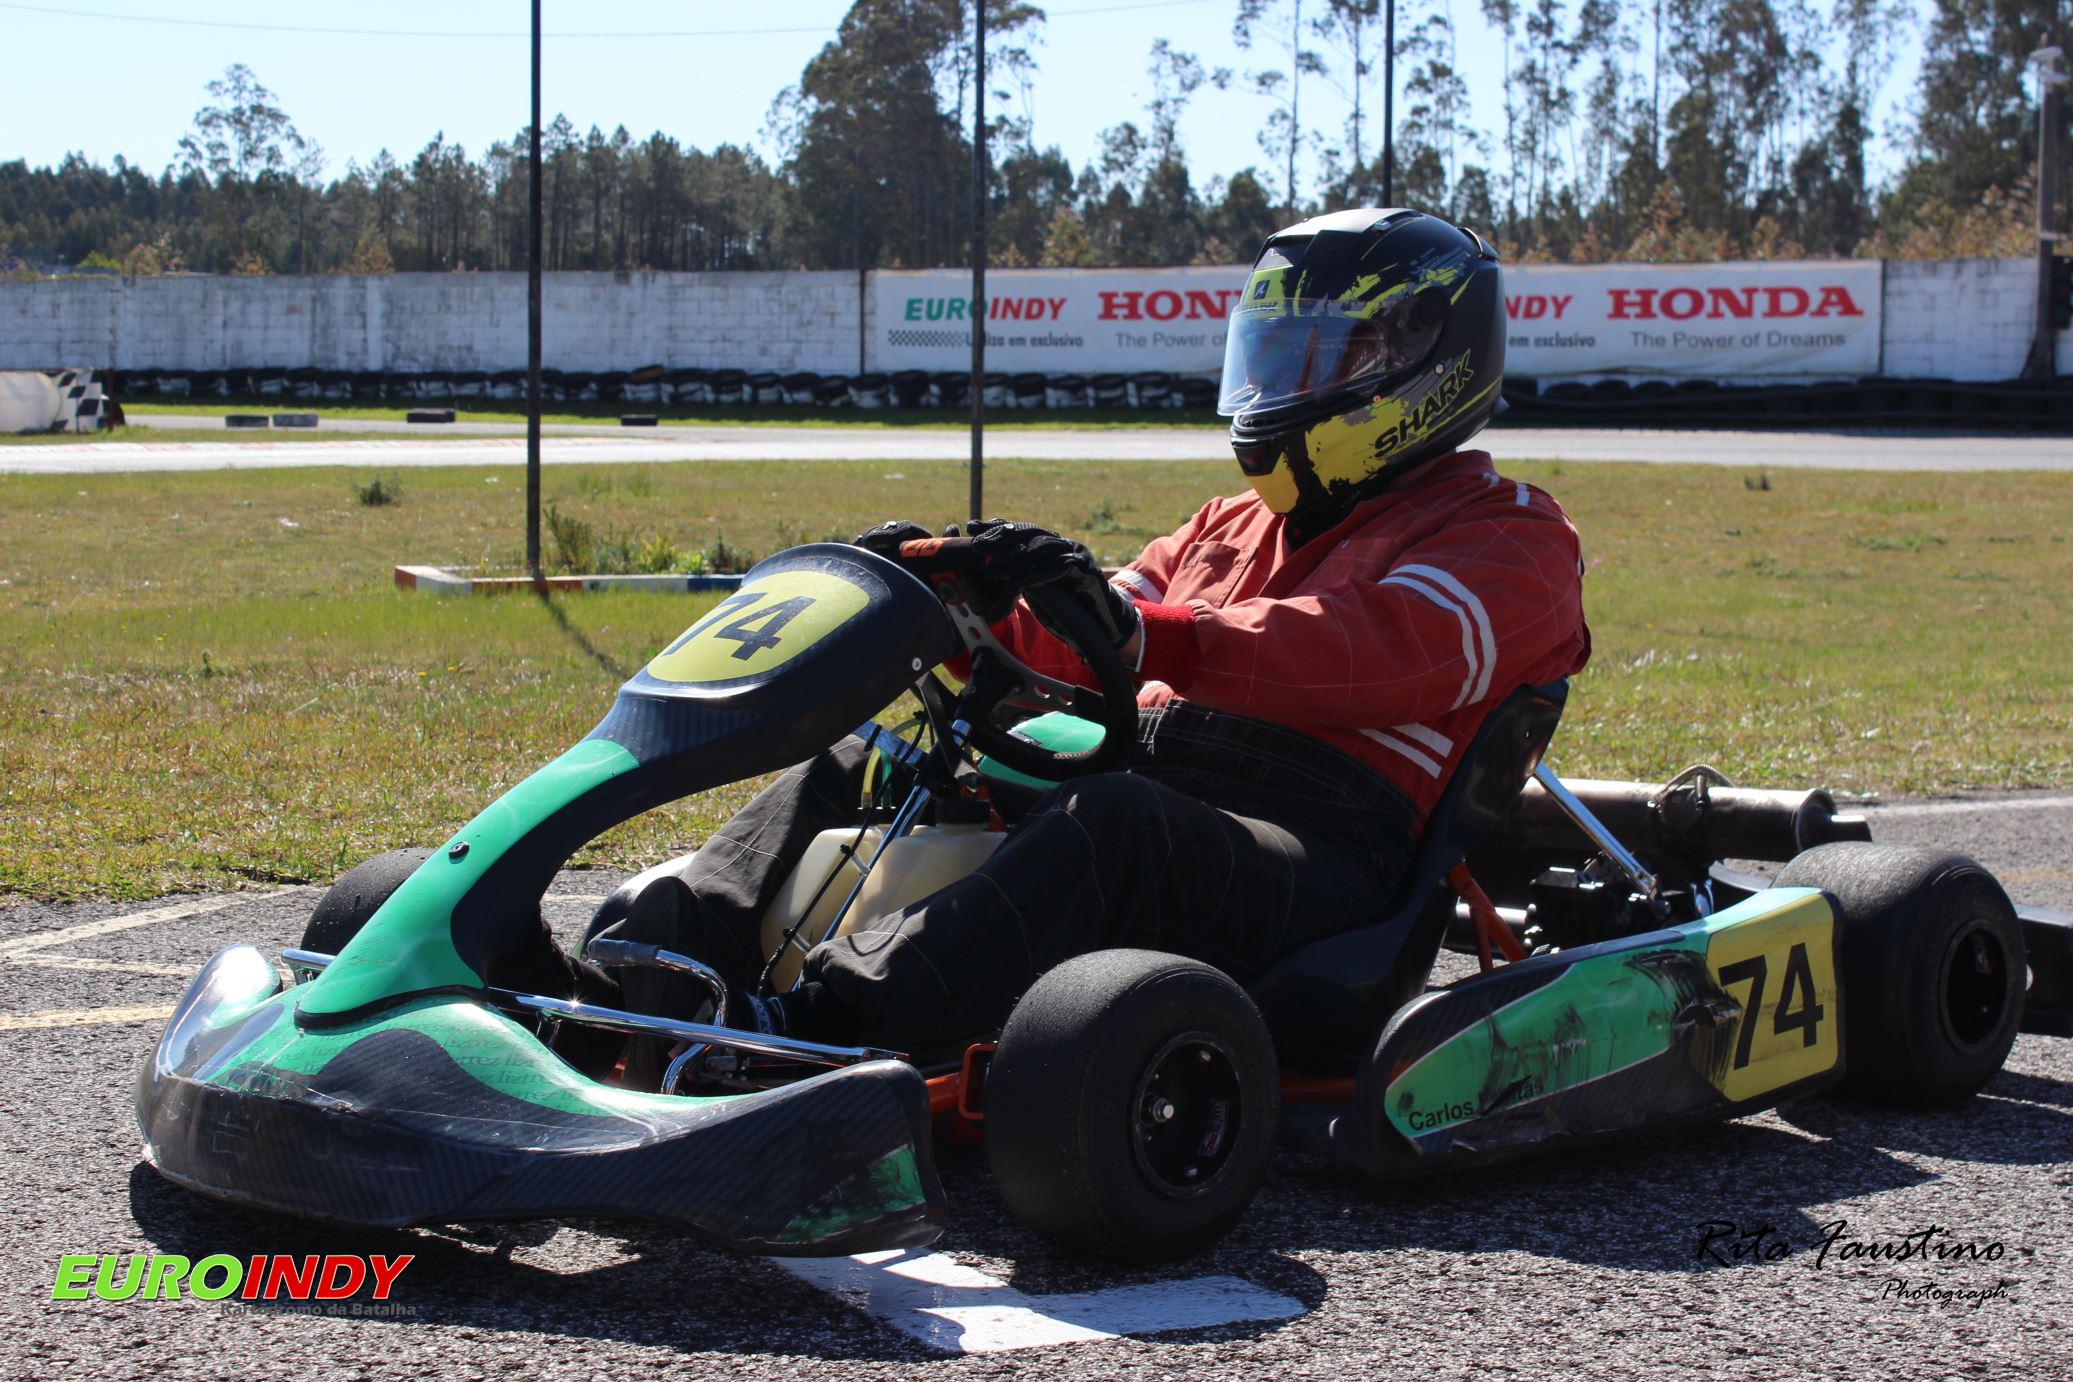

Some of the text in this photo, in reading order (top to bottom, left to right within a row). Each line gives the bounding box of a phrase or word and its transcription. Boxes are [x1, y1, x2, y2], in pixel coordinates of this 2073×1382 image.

[1098, 290, 1242, 321] HON
[1505, 293, 1573, 320] NDY
[1607, 287, 1864, 320] HONDA
[1009, 336, 1027, 347] em
[1030, 331, 1084, 347] exclusivo
[1115, 332, 1147, 347] The
[1152, 332, 1206, 347] Power
[1508, 331, 1596, 347] em exclusivo
[1631, 329, 1848, 349] The Power of Dreams
[1374, 347, 1474, 458] SHARK
[661, 592, 817, 661] 74
[1717, 943, 1824, 1070] 74
[1409, 1098, 1475, 1131] Carlos
